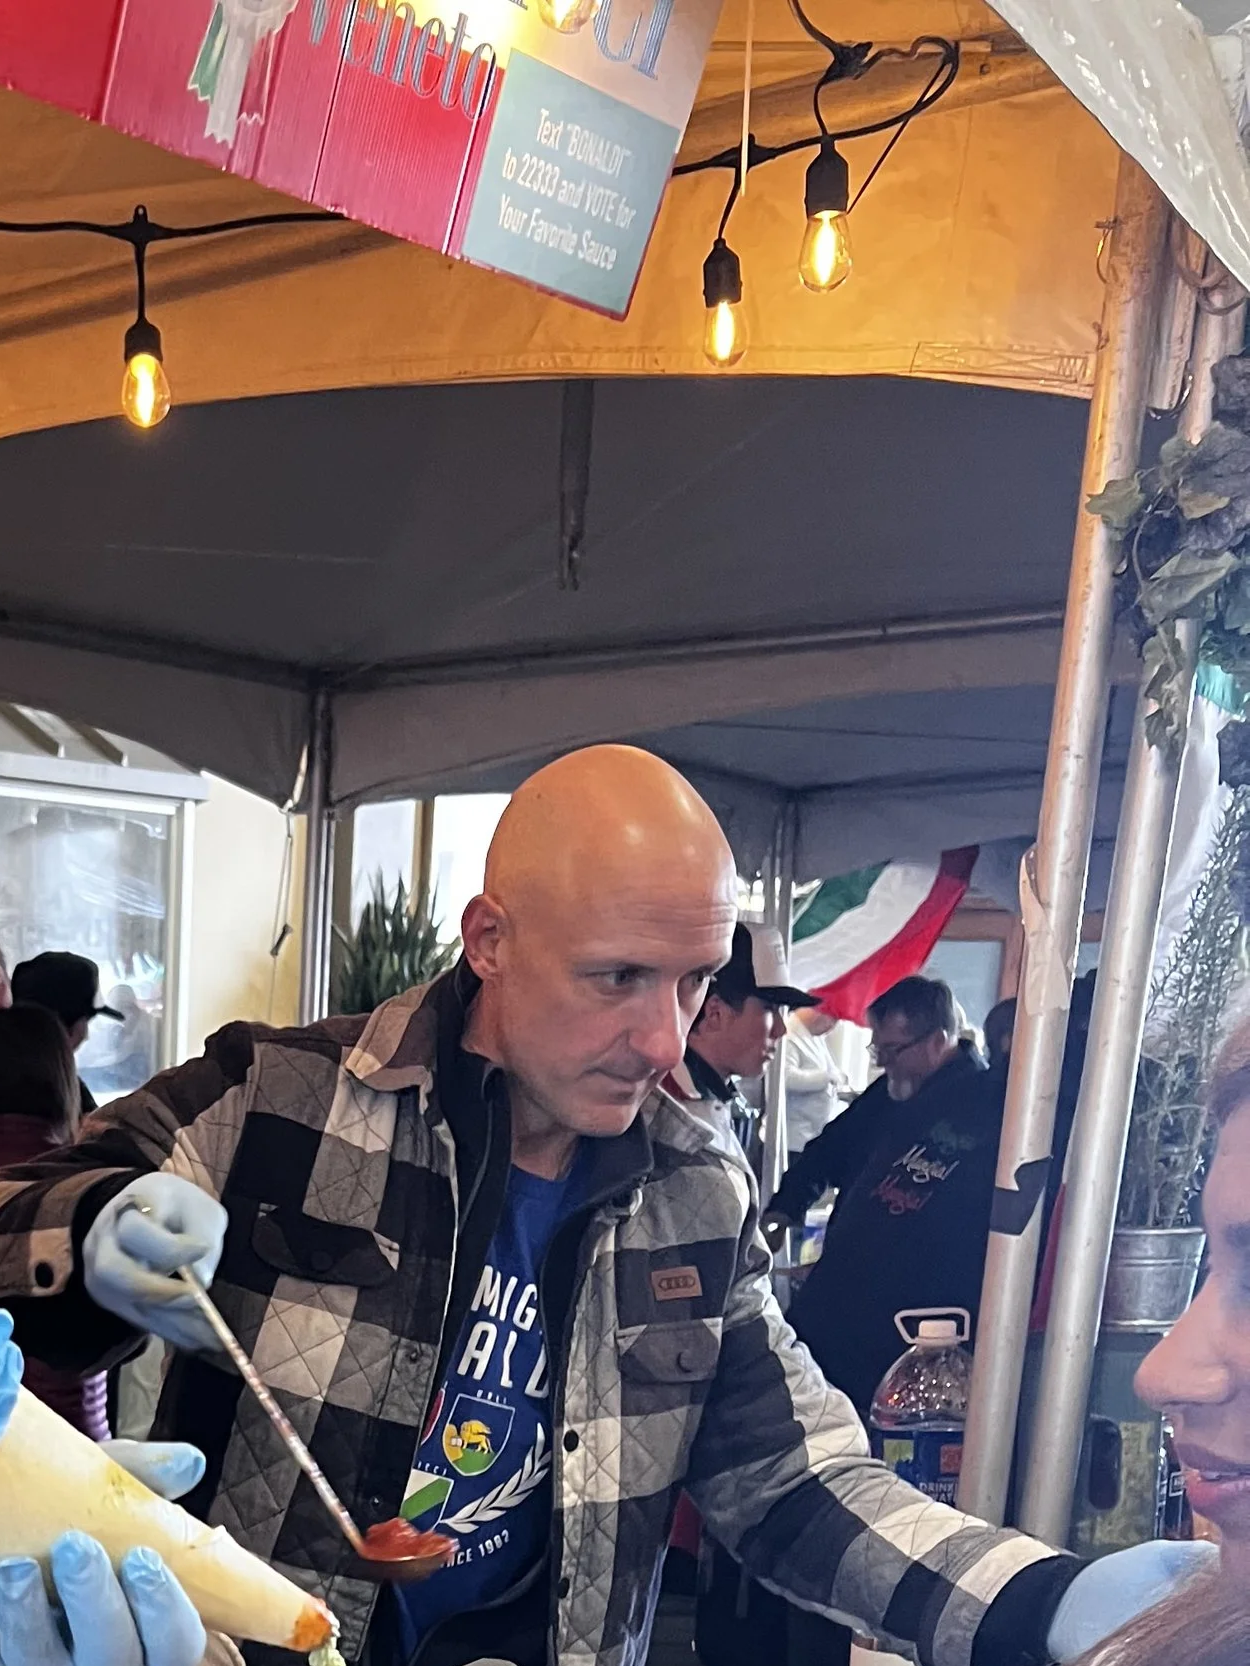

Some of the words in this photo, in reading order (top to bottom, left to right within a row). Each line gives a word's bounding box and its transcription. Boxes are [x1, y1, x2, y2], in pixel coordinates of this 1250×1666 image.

[536, 107, 564, 150] Text
[502, 147, 517, 180] to
[516, 153, 560, 197] 22333
[557, 177, 586, 209] and
[584, 181, 618, 222] VOTE
[615, 197, 637, 230] for
[498, 194, 528, 234] Your
[526, 208, 578, 255] Favorite
[578, 230, 617, 270] Sauce
